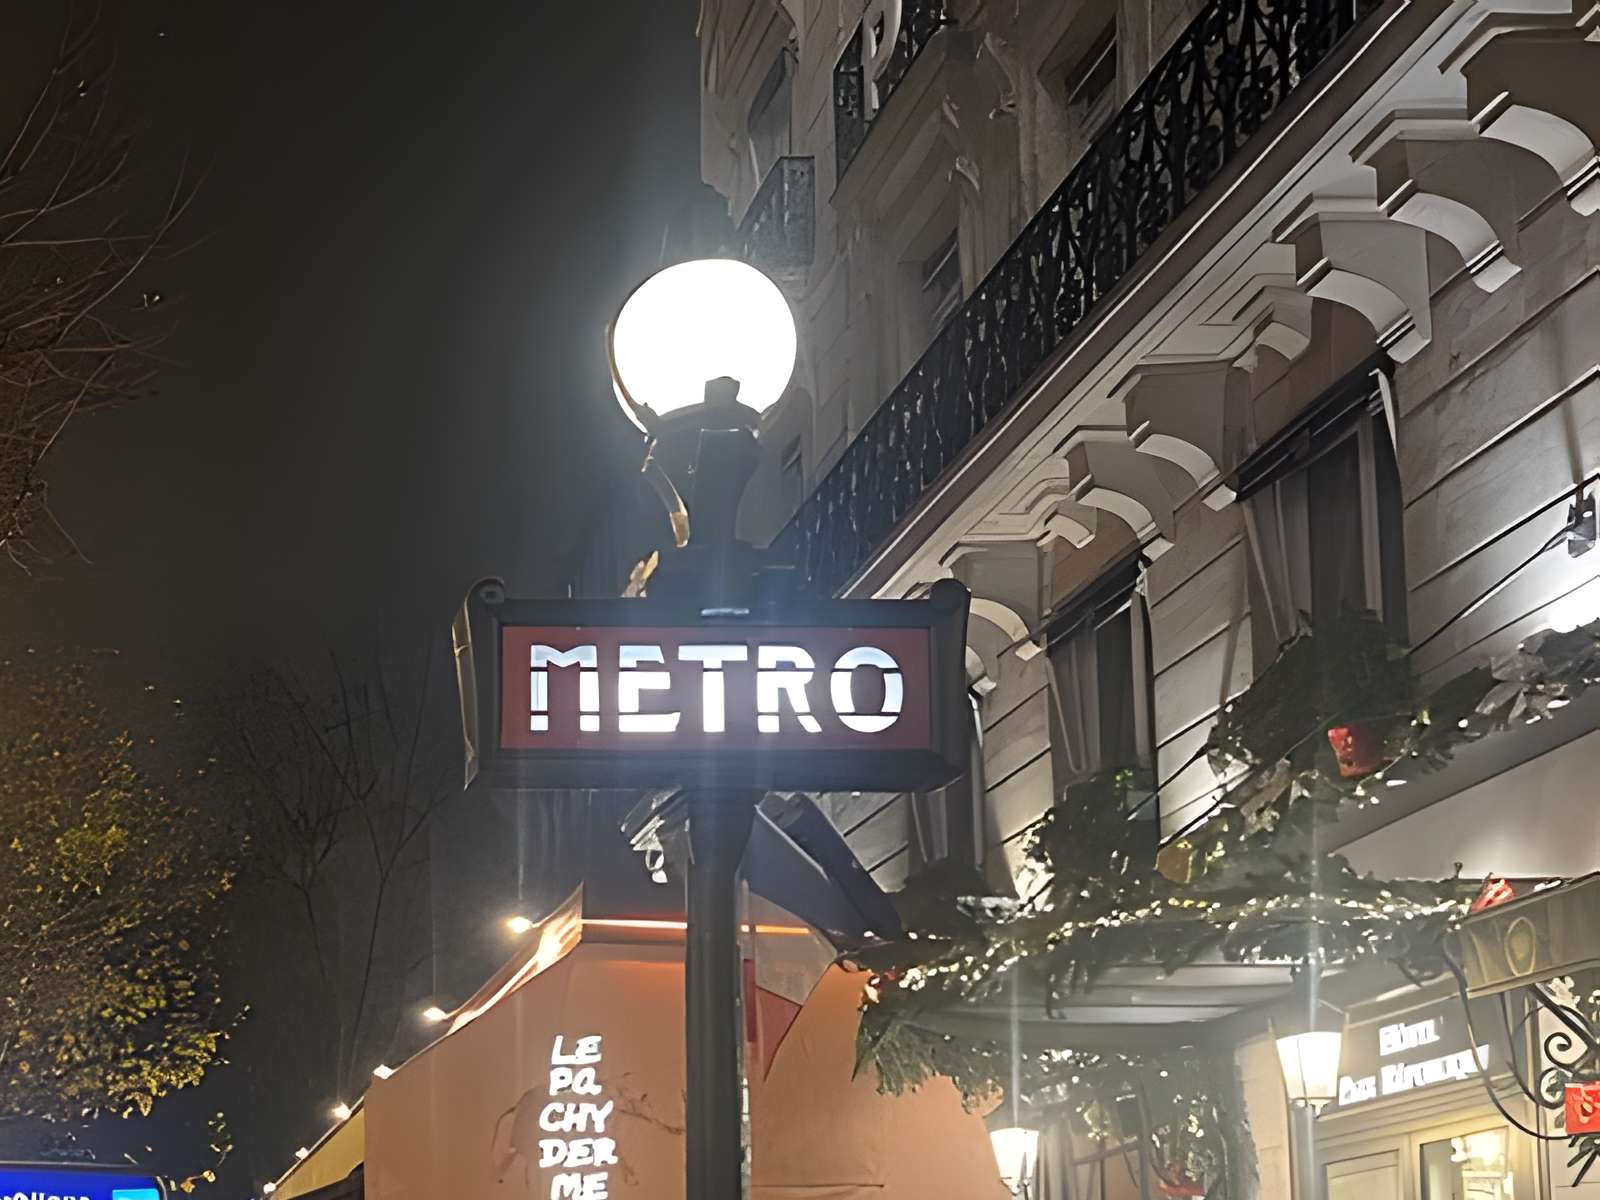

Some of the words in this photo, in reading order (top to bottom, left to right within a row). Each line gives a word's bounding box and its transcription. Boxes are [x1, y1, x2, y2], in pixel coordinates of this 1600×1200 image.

[530, 644, 903, 733] METRO
[551, 1034, 602, 1065] LE
[538, 1100, 614, 1133] CHY
[538, 1137, 618, 1168] DER
